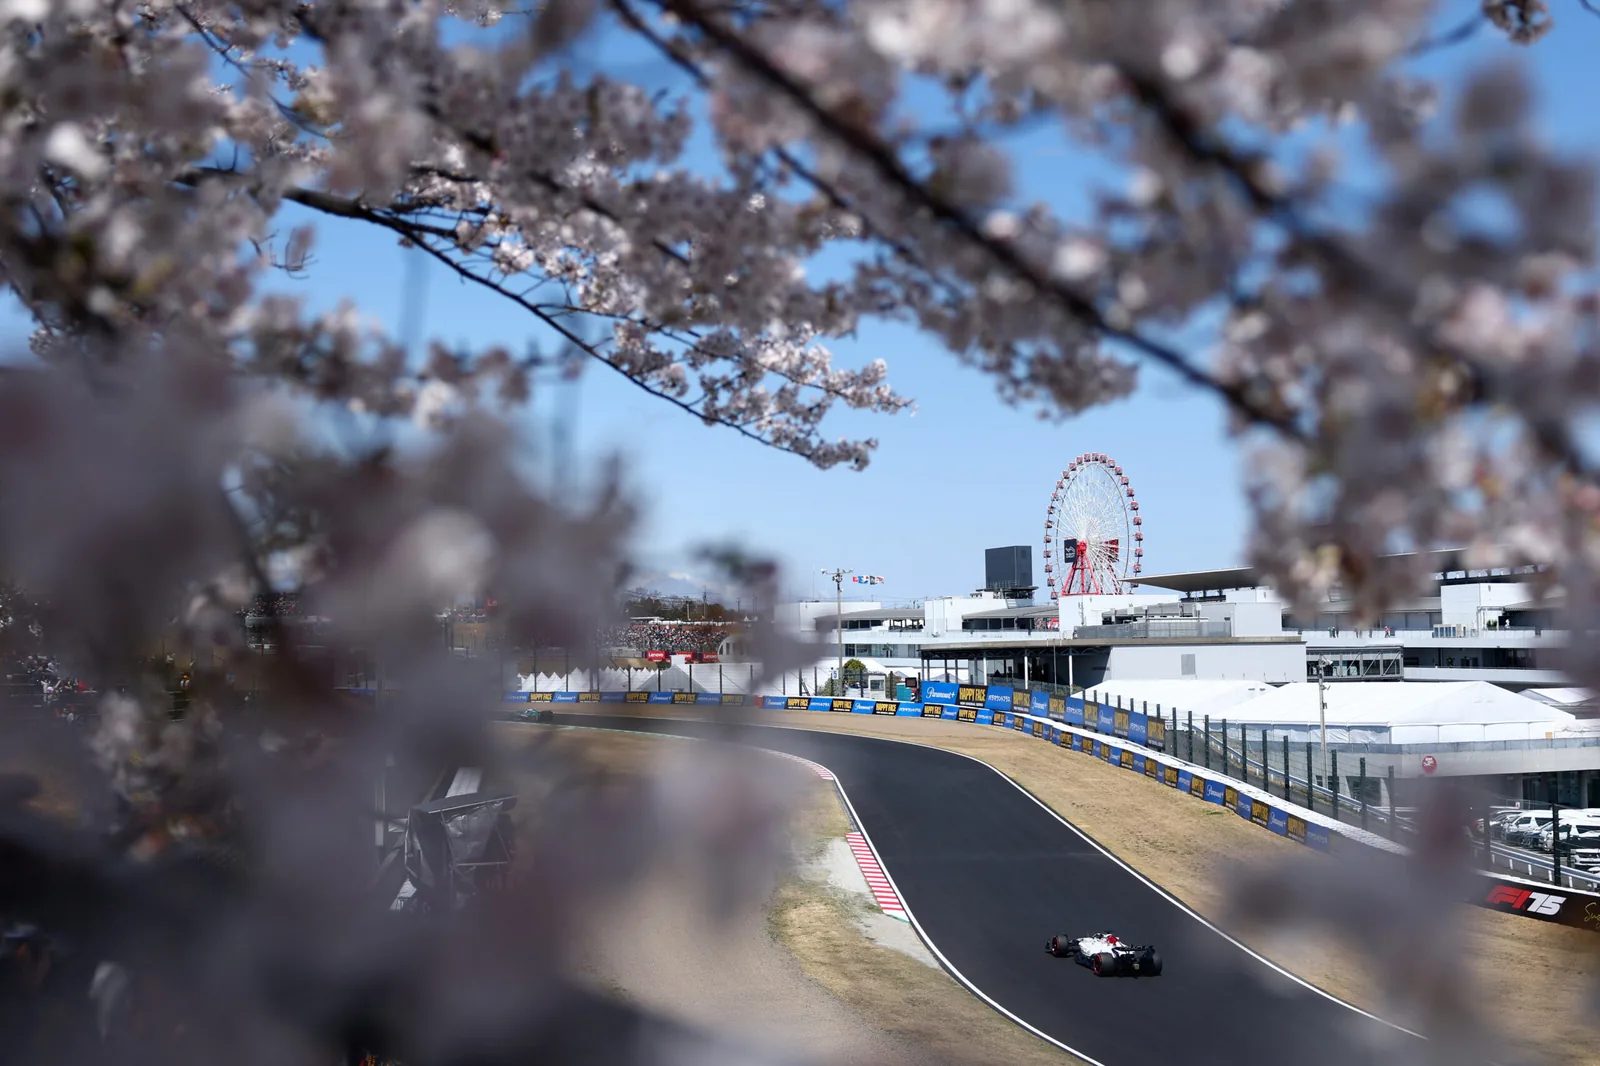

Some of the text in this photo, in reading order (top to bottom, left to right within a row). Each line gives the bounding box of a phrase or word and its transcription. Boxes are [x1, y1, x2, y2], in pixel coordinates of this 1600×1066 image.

[926, 686, 955, 699] Paramount+
[959, 687, 986, 702] HAPPY FACE
[876, 703, 897, 712] HAPPY FACE
[924, 705, 942, 715] HAPPY FACE
